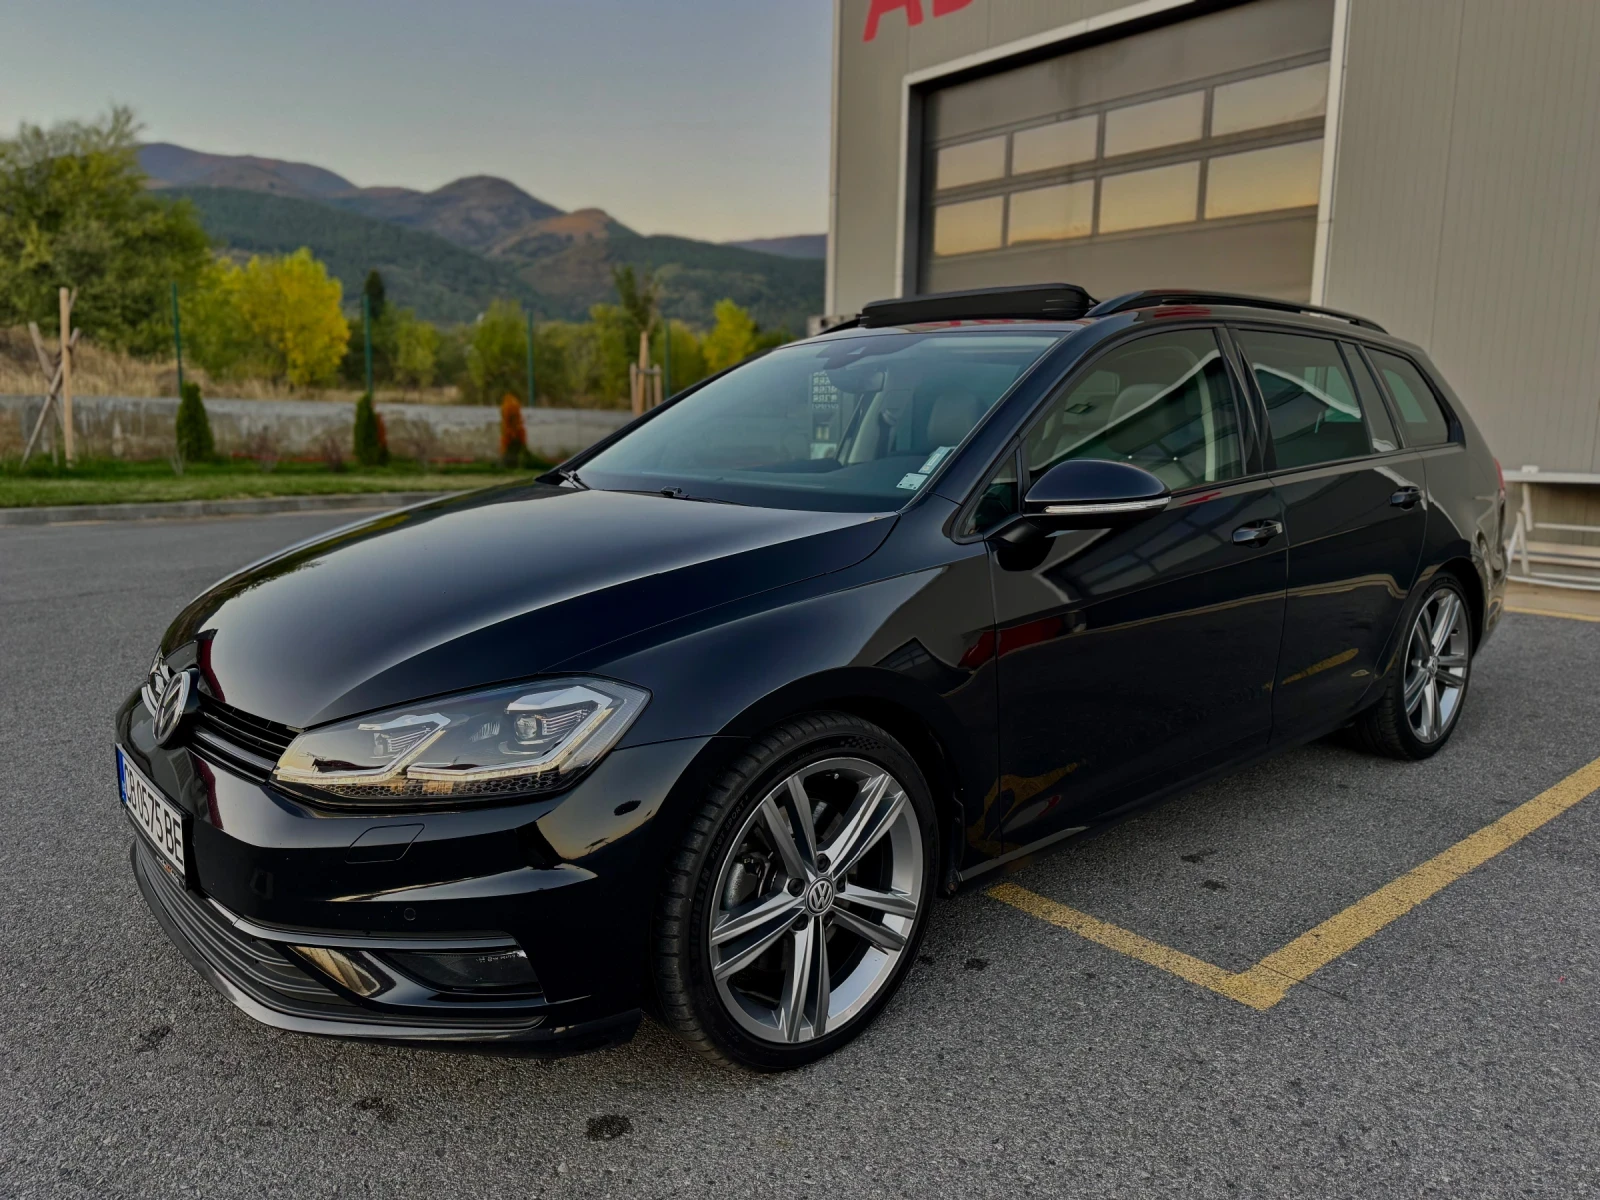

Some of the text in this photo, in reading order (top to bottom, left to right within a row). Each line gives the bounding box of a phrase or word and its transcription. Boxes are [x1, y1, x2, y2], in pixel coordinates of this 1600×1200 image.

[136, 780, 163, 843] 0575
[164, 808, 184, 866] BE
[711, 834, 725, 860] PILOT
[725, 802, 744, 831] SPORT
[811, 882, 832, 910] VW
